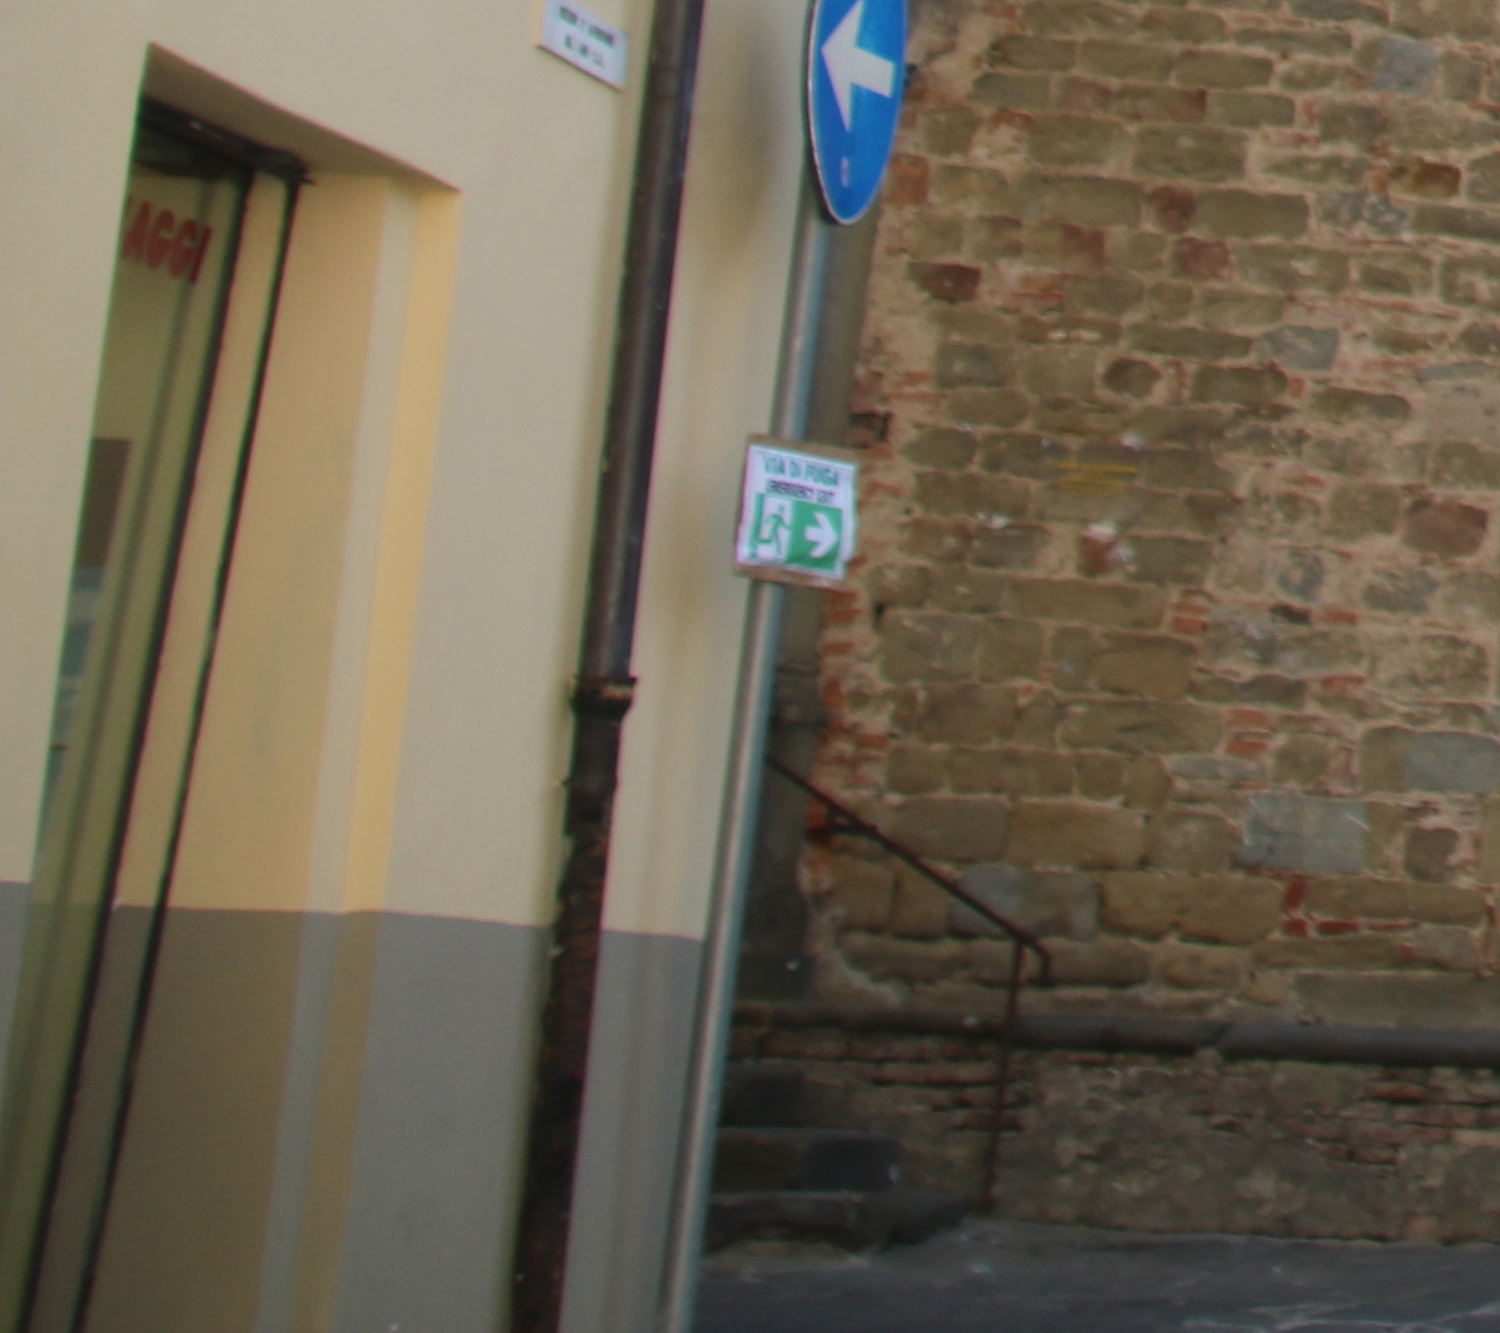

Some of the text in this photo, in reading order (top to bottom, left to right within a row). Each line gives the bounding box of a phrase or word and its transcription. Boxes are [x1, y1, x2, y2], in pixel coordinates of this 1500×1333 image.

[120, 193, 214, 285] AGGI
[763, 453, 785, 475] VIA
[804, 464, 839, 487] FUGA
